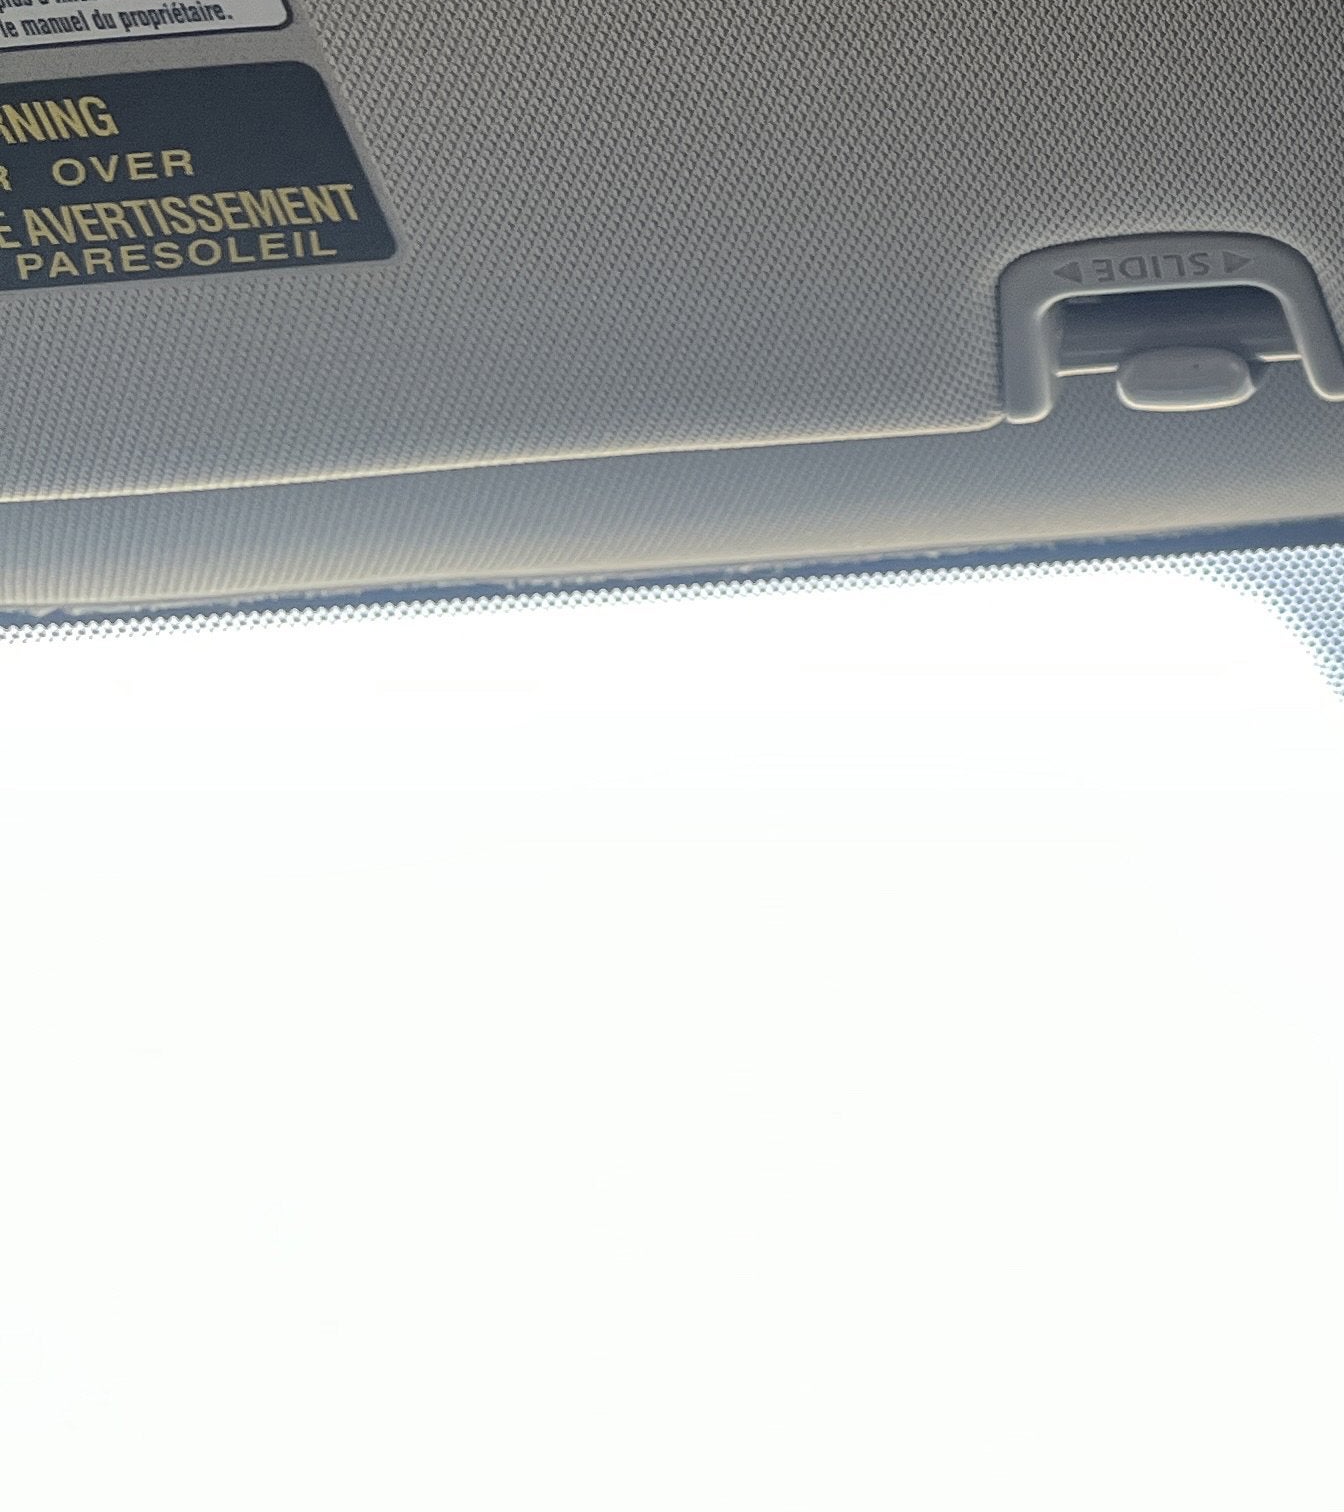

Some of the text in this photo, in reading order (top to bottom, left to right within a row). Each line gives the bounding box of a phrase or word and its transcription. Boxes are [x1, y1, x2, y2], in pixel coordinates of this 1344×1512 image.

[21, 9, 91, 36] manuel
[92, 8, 117, 30] du
[118, 0, 233, 33] propriétaire.
[52, 148, 195, 186] OVER
[23, 183, 359, 247] AVERTISSEMENT
[16, 230, 338, 280] PARESOLEIL
[1091, 252, 1209, 282] SLIDE
